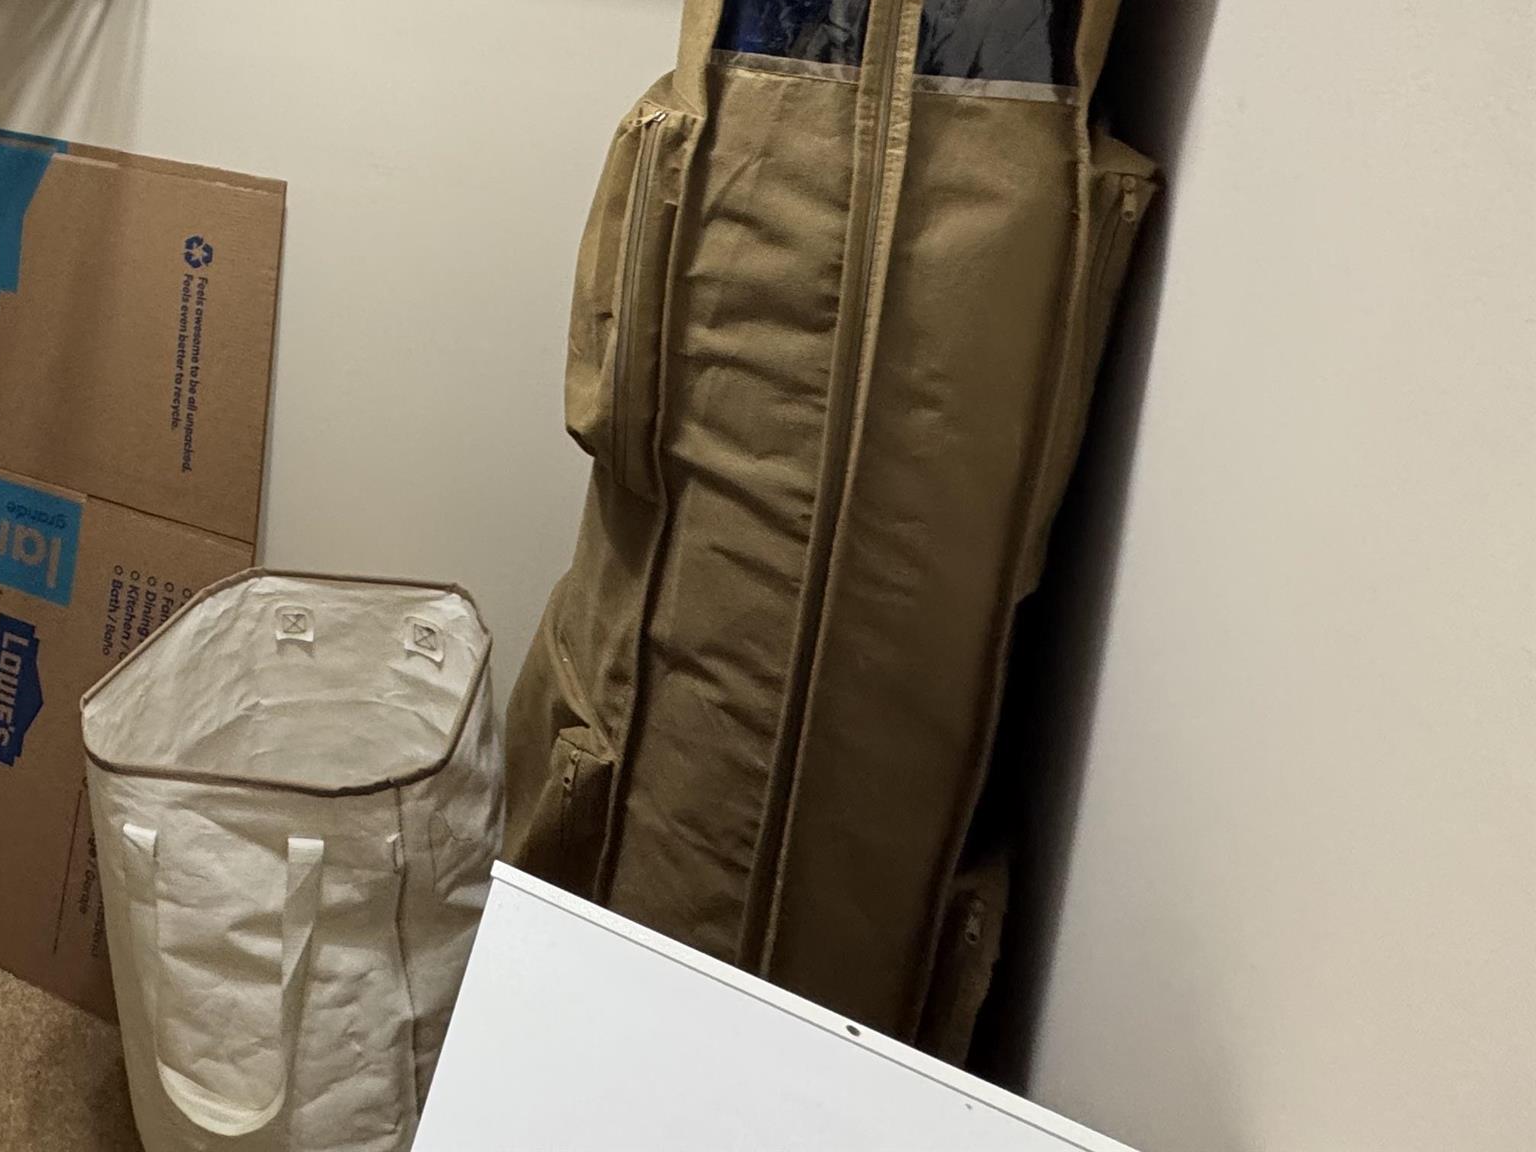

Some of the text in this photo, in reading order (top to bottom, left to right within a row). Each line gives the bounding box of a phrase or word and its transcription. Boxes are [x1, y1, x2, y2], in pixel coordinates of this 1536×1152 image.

[181, 272, 193, 303] Feels
[195, 276, 207, 306] Feels
[179, 304, 188, 332] even
[190, 307, 203, 364] awesome
[175, 333, 188, 370] better
[174, 371, 184, 384] to
[190, 365, 199, 378] to
[188, 379, 199, 395] be
[187, 396, 197, 411] all
[109, 578, 125, 614] Bath
[120, 584, 139, 640] Kitchen
[137, 590, 156, 637] Dining
